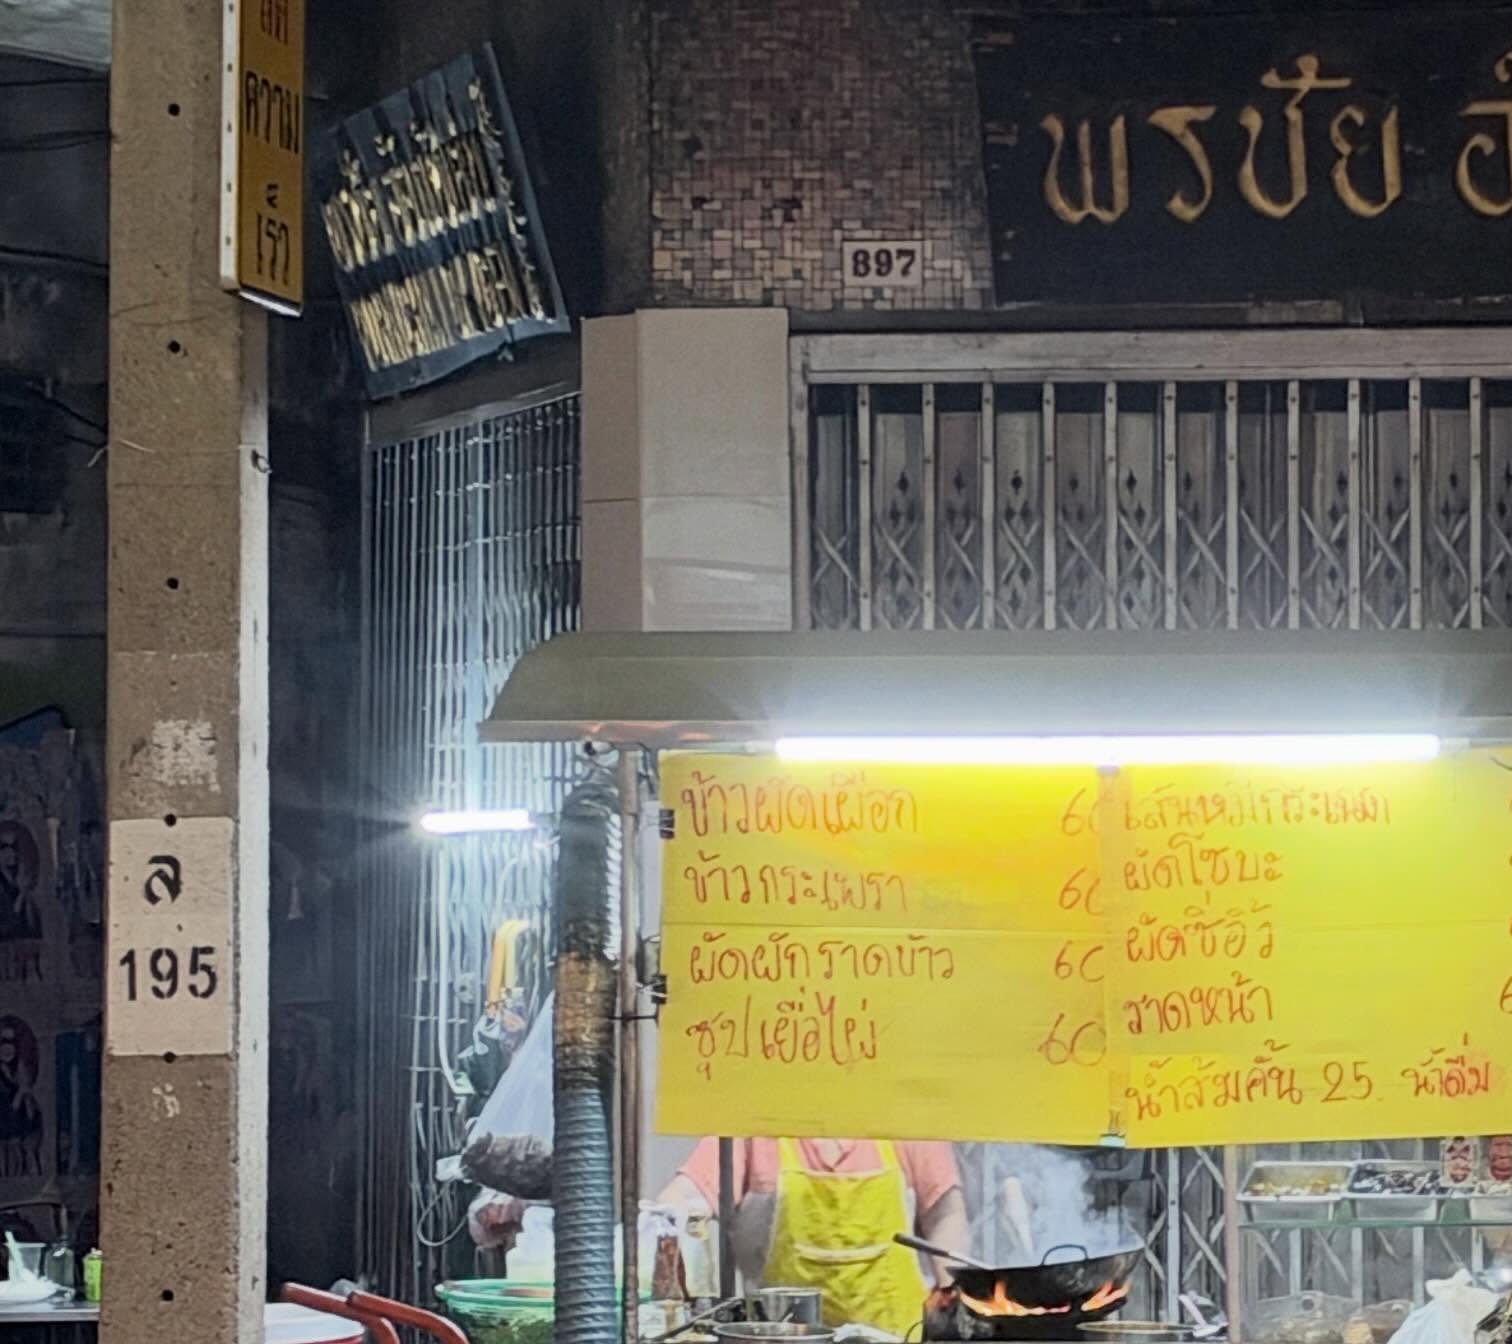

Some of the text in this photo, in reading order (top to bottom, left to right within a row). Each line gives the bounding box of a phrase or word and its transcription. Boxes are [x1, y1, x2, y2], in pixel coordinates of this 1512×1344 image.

[246, 70, 300, 154] ความ
[1040, 53, 1401, 224] พรชัย
[255, 184, 291, 287] เร็ว
[852, 248, 917, 278] 897
[119, 946, 219, 1001] 195
[1123, 971, 1274, 1036] ราดหน้า
